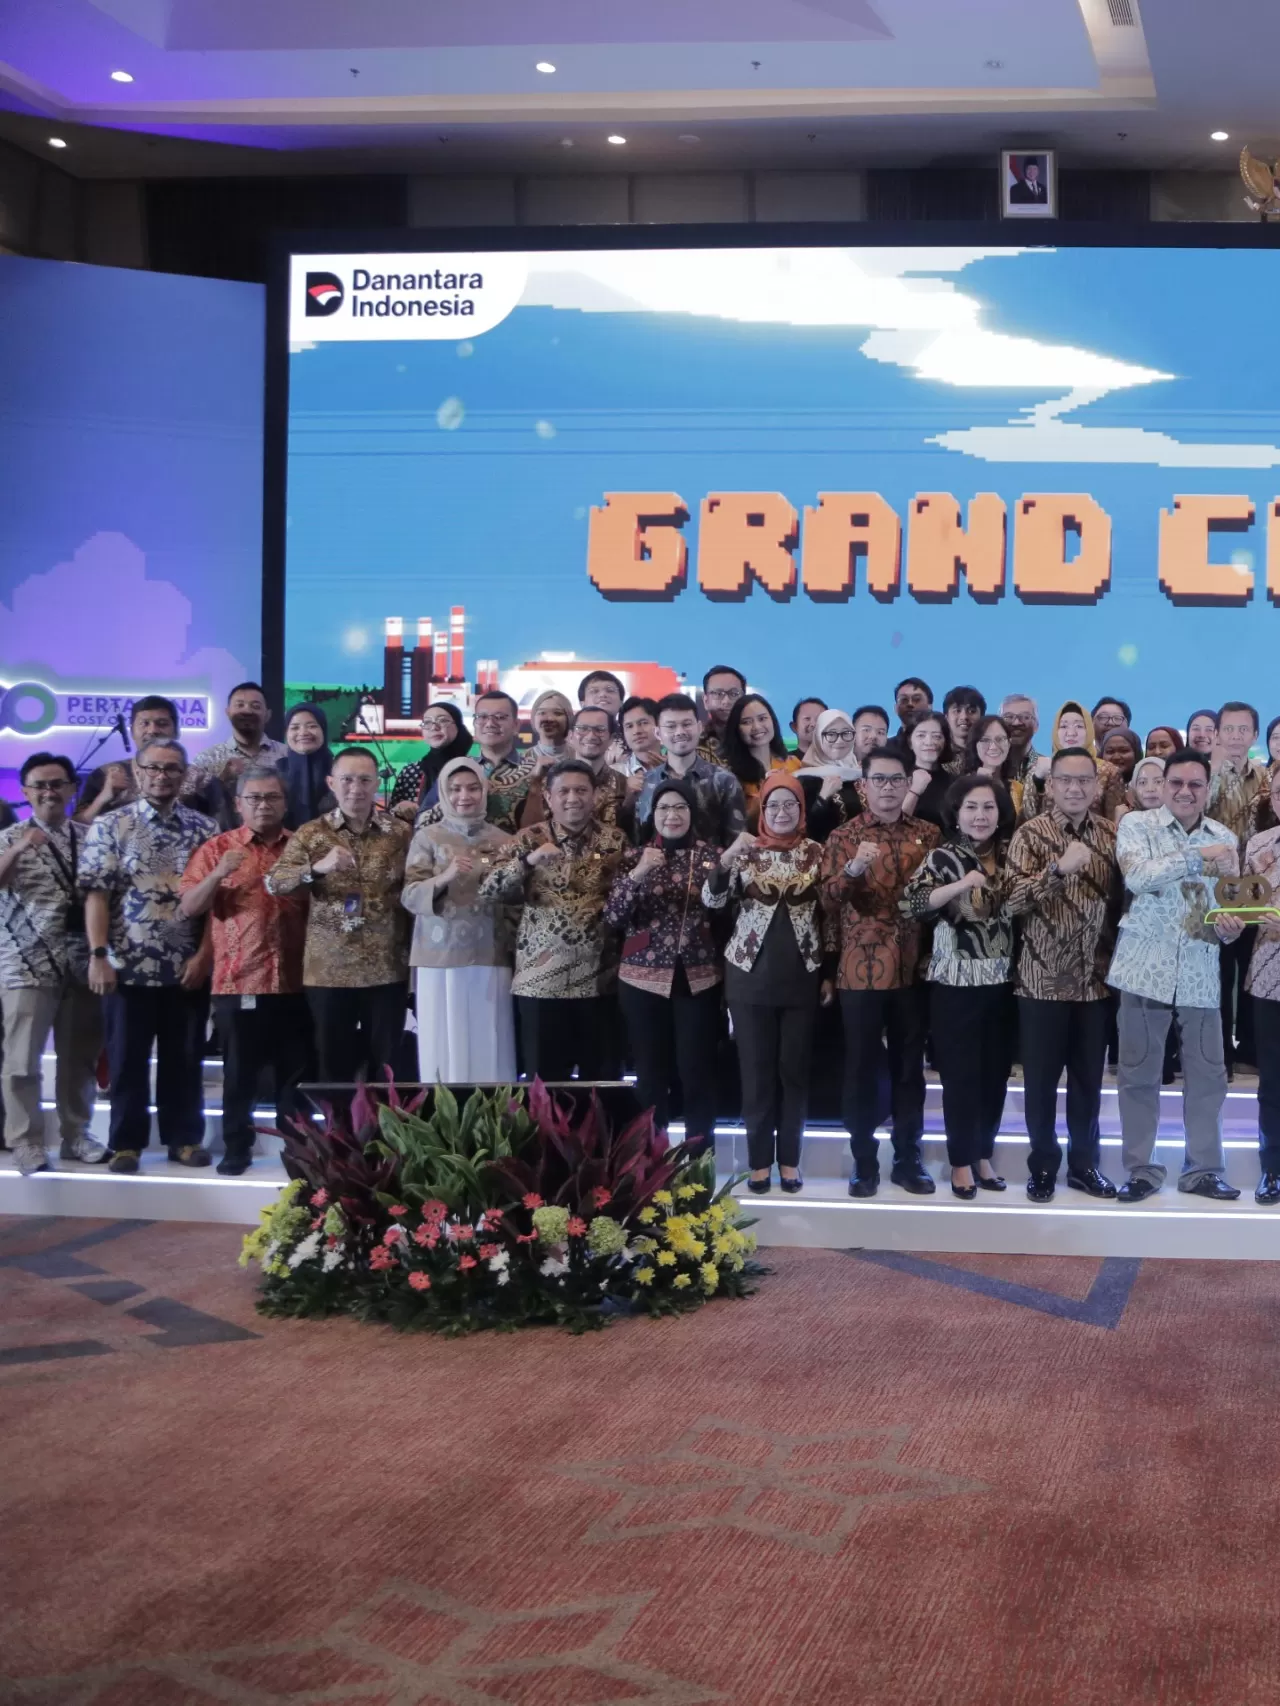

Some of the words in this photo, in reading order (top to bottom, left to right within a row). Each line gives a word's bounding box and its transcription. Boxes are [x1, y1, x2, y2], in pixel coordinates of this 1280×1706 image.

[352, 269, 483, 290] Danantara
[352, 294, 475, 317] Indonesia
[587, 491, 1112, 605] GRAND
[67, 697, 205, 714] PERTANA
[67, 715, 105, 725] COST
